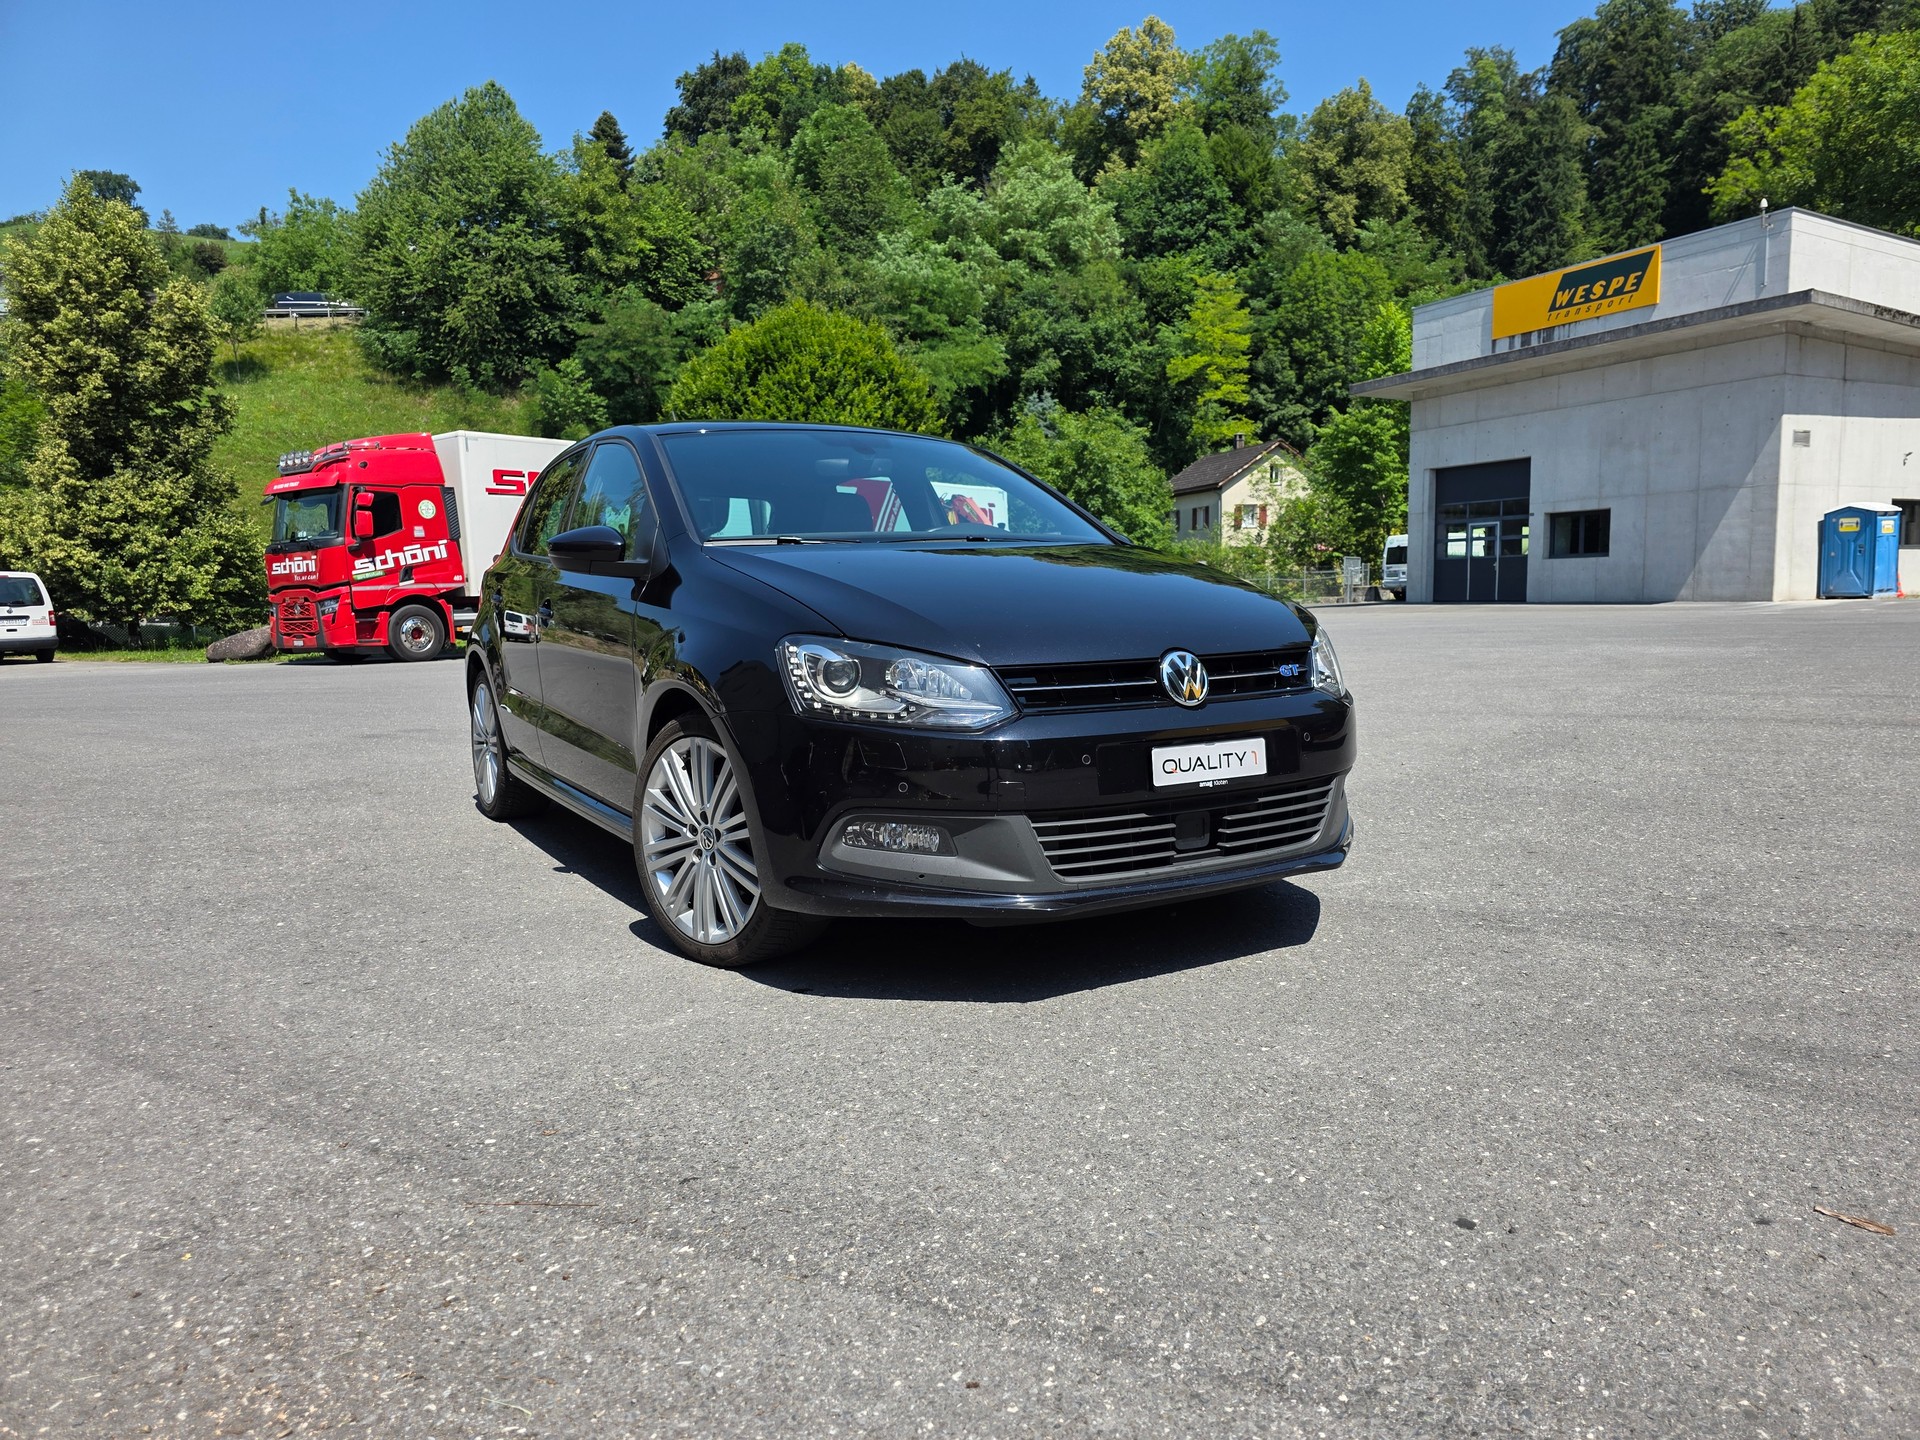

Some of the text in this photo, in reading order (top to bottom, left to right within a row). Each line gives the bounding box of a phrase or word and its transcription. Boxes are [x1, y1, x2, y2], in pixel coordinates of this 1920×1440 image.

[1555, 271, 1642, 308] WESPE
[1547, 294, 1634, 321] transport
[1280, 664, 1299, 676] GT
[1162, 750, 1258, 775] QUALITY 1
